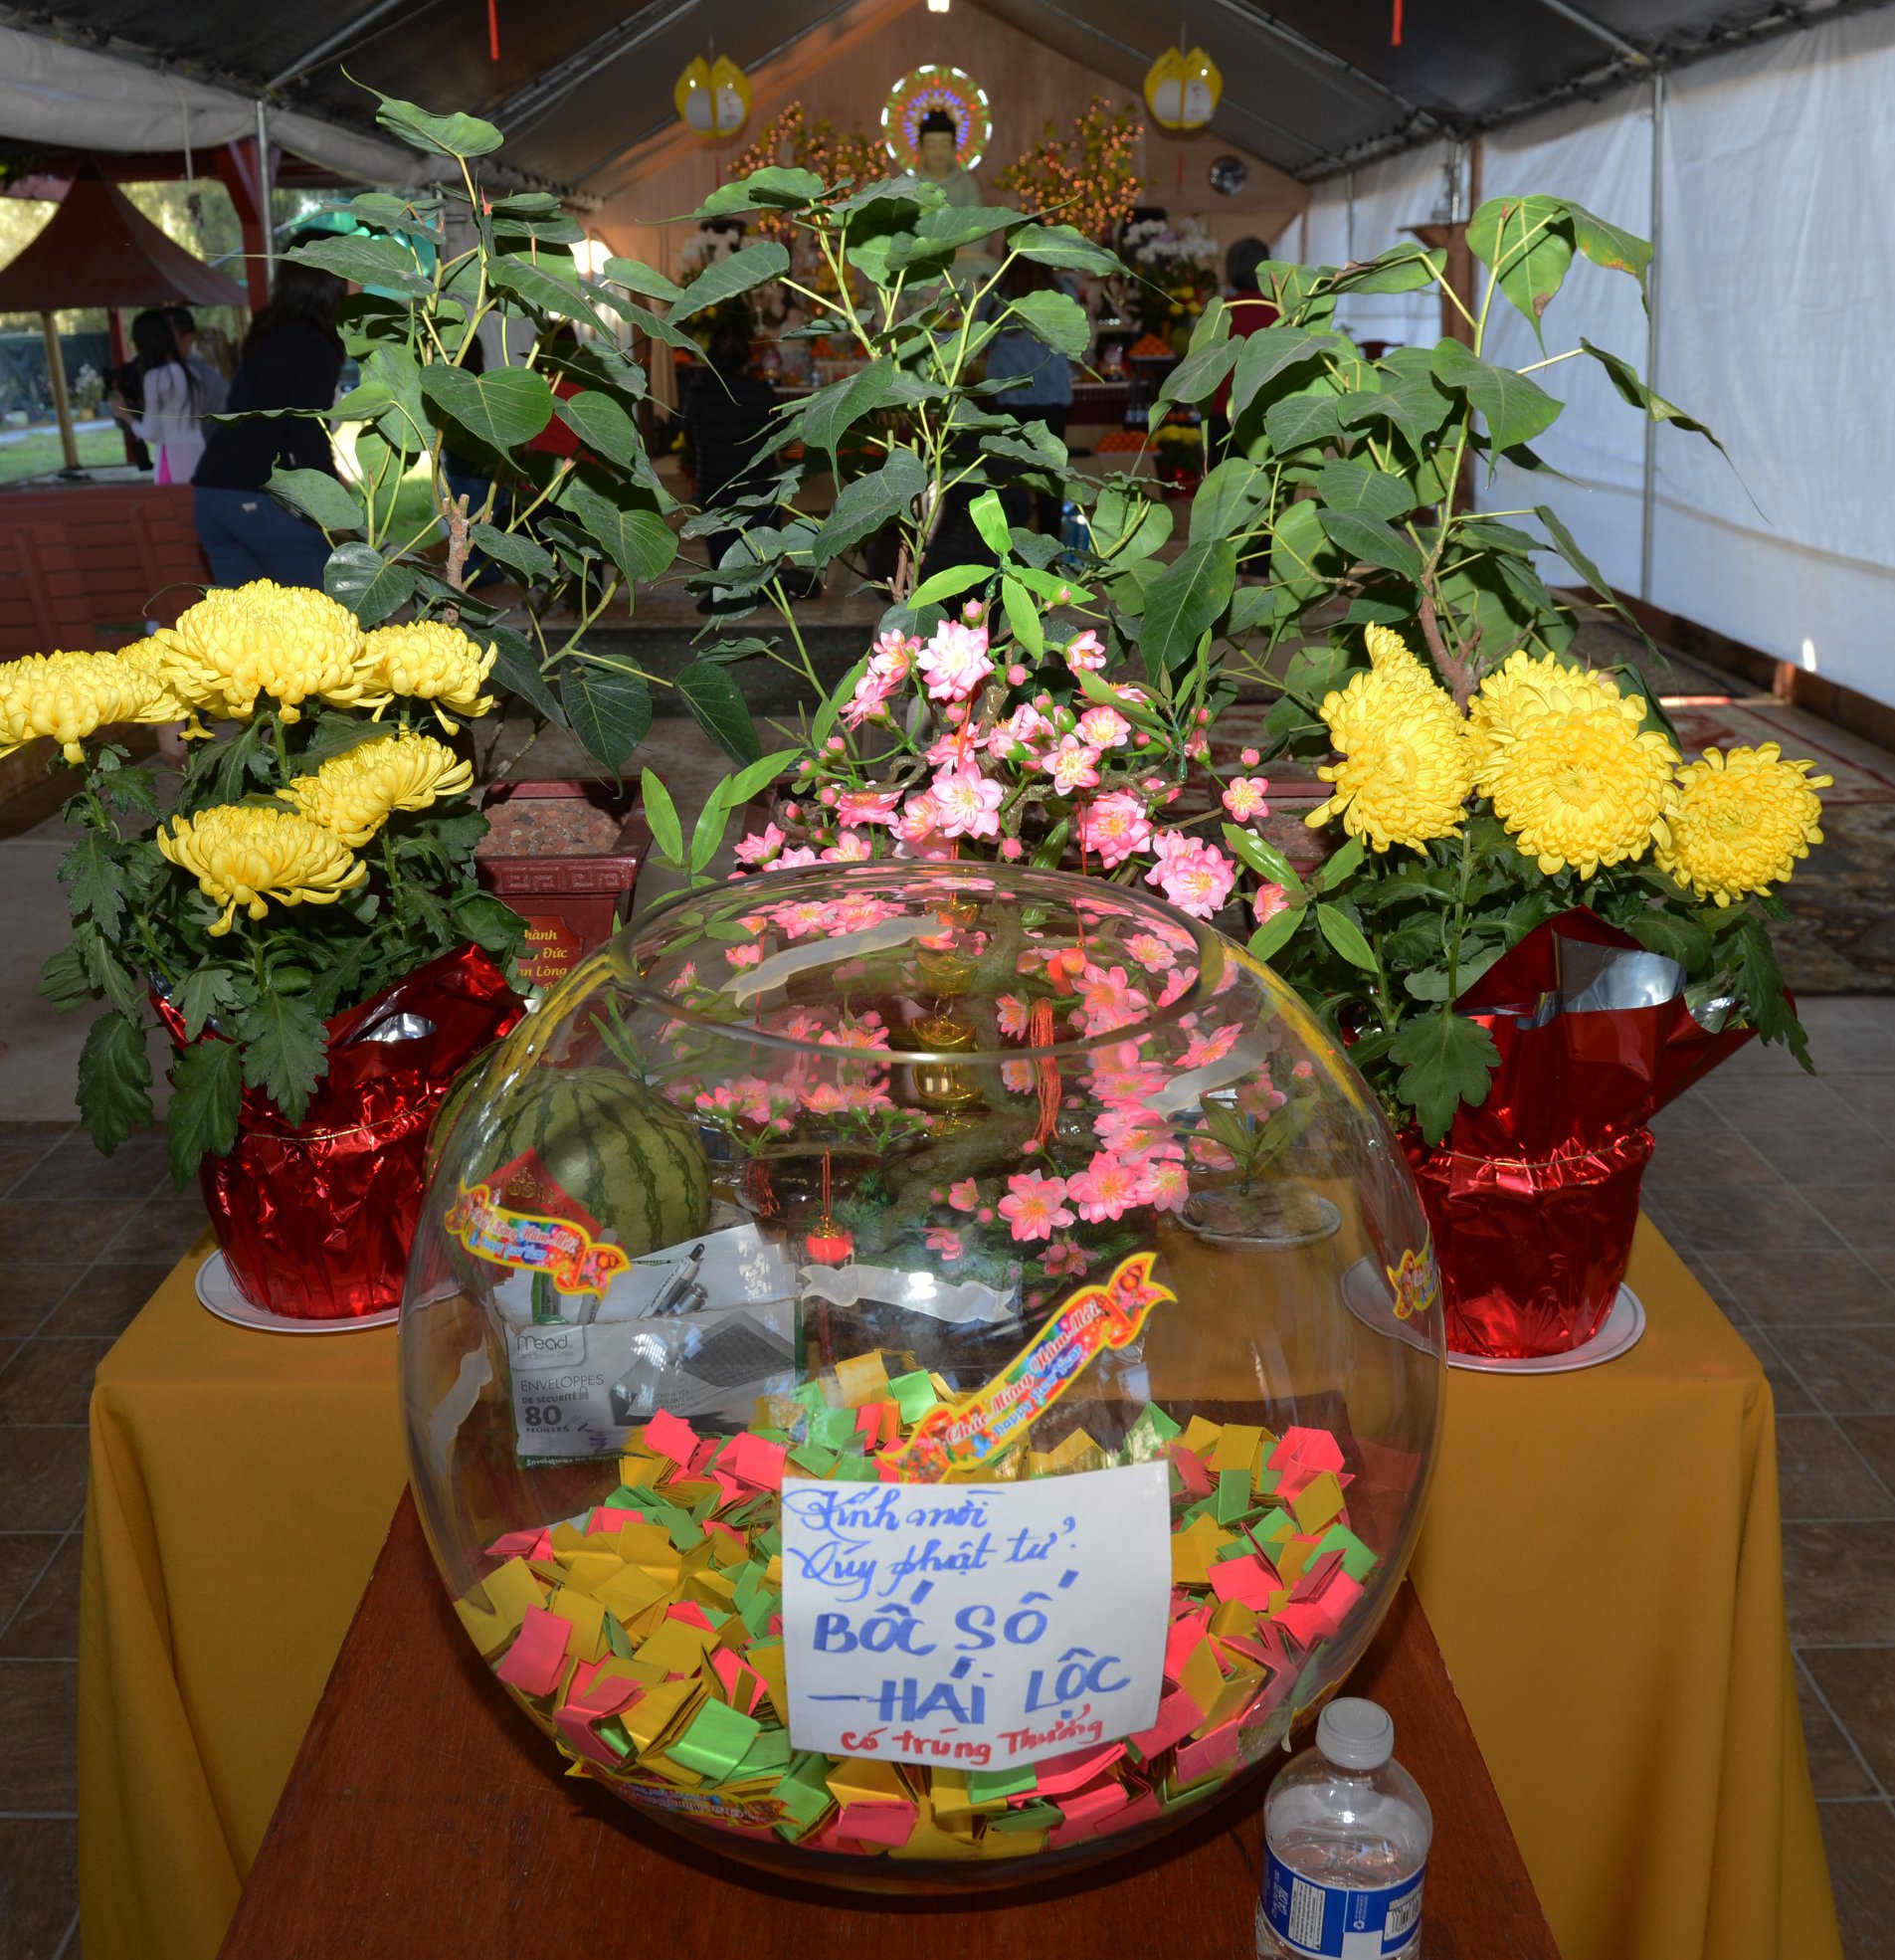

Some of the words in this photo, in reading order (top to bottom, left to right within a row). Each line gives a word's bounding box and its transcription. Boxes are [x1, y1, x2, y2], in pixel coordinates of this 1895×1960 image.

[524, 929, 558, 940] hành
[542, 947, 568, 958] Đức
[536, 965, 568, 978] Lòng
[520, 1374, 605, 1393] ENVELOPPES
[536, 1392, 577, 1404] SÉCURITÉ
[524, 1405, 562, 1427] 80
[813, 1579, 937, 1657] BỐC
[954, 1569, 1079, 1651] SỐ
[1024, 1647, 1131, 1719] LỘC
